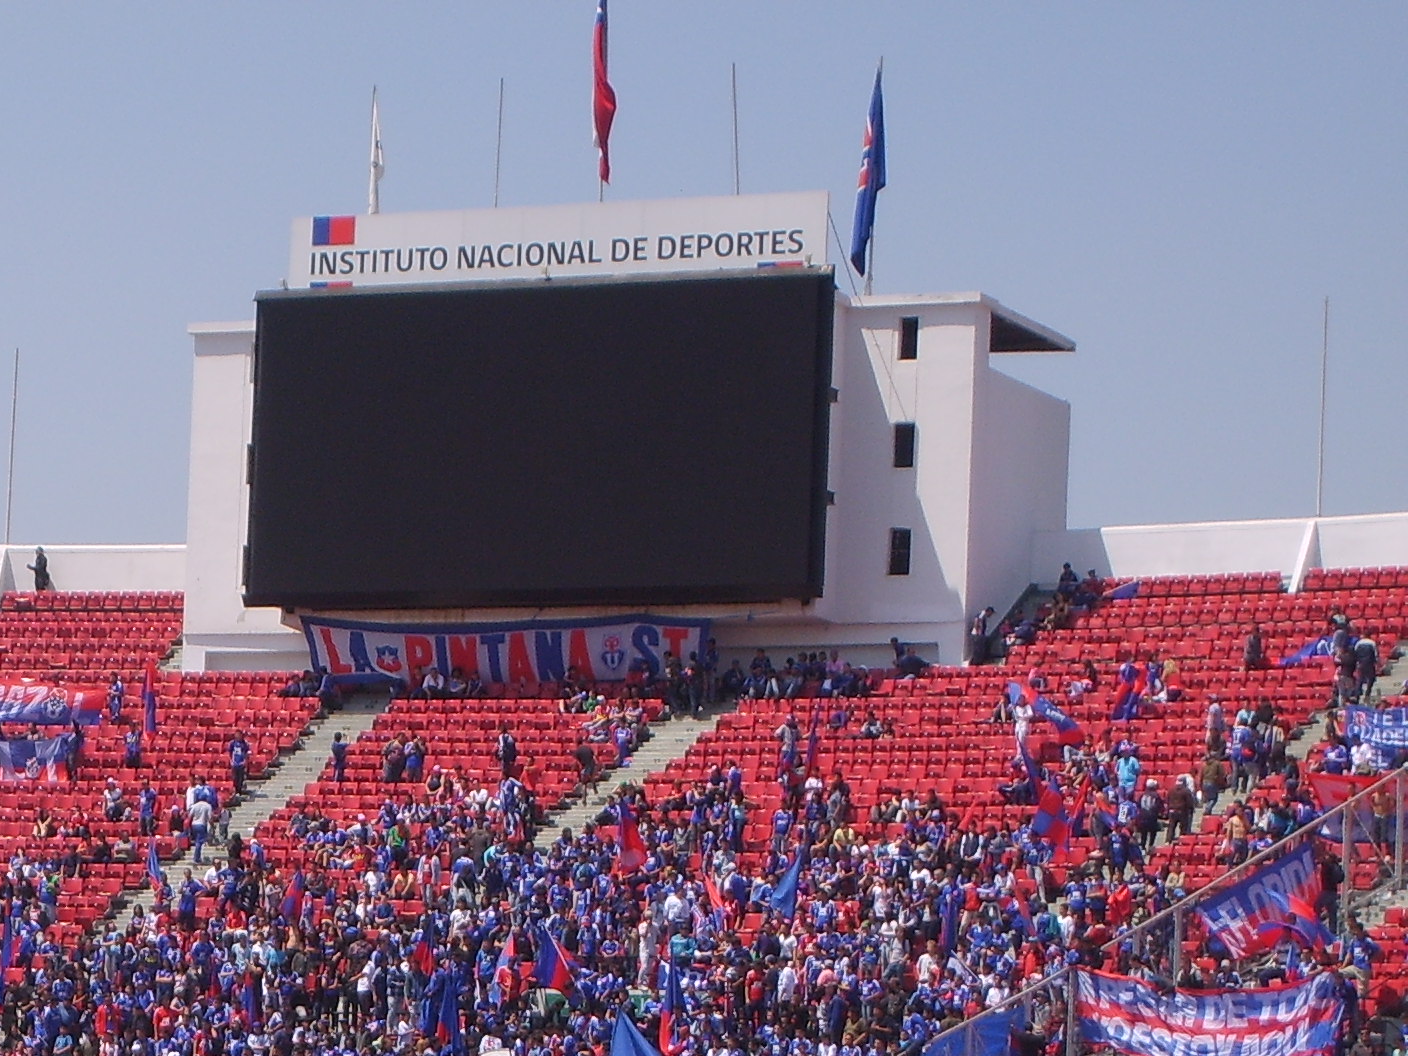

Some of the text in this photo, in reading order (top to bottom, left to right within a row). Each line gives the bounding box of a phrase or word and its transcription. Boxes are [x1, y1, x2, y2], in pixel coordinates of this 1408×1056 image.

[310, 229, 804, 275] INSTITUTO NACIONAL DE DEPORTES
[319, 627, 377, 674] LA
[404, 628, 595, 684] PINTANA
